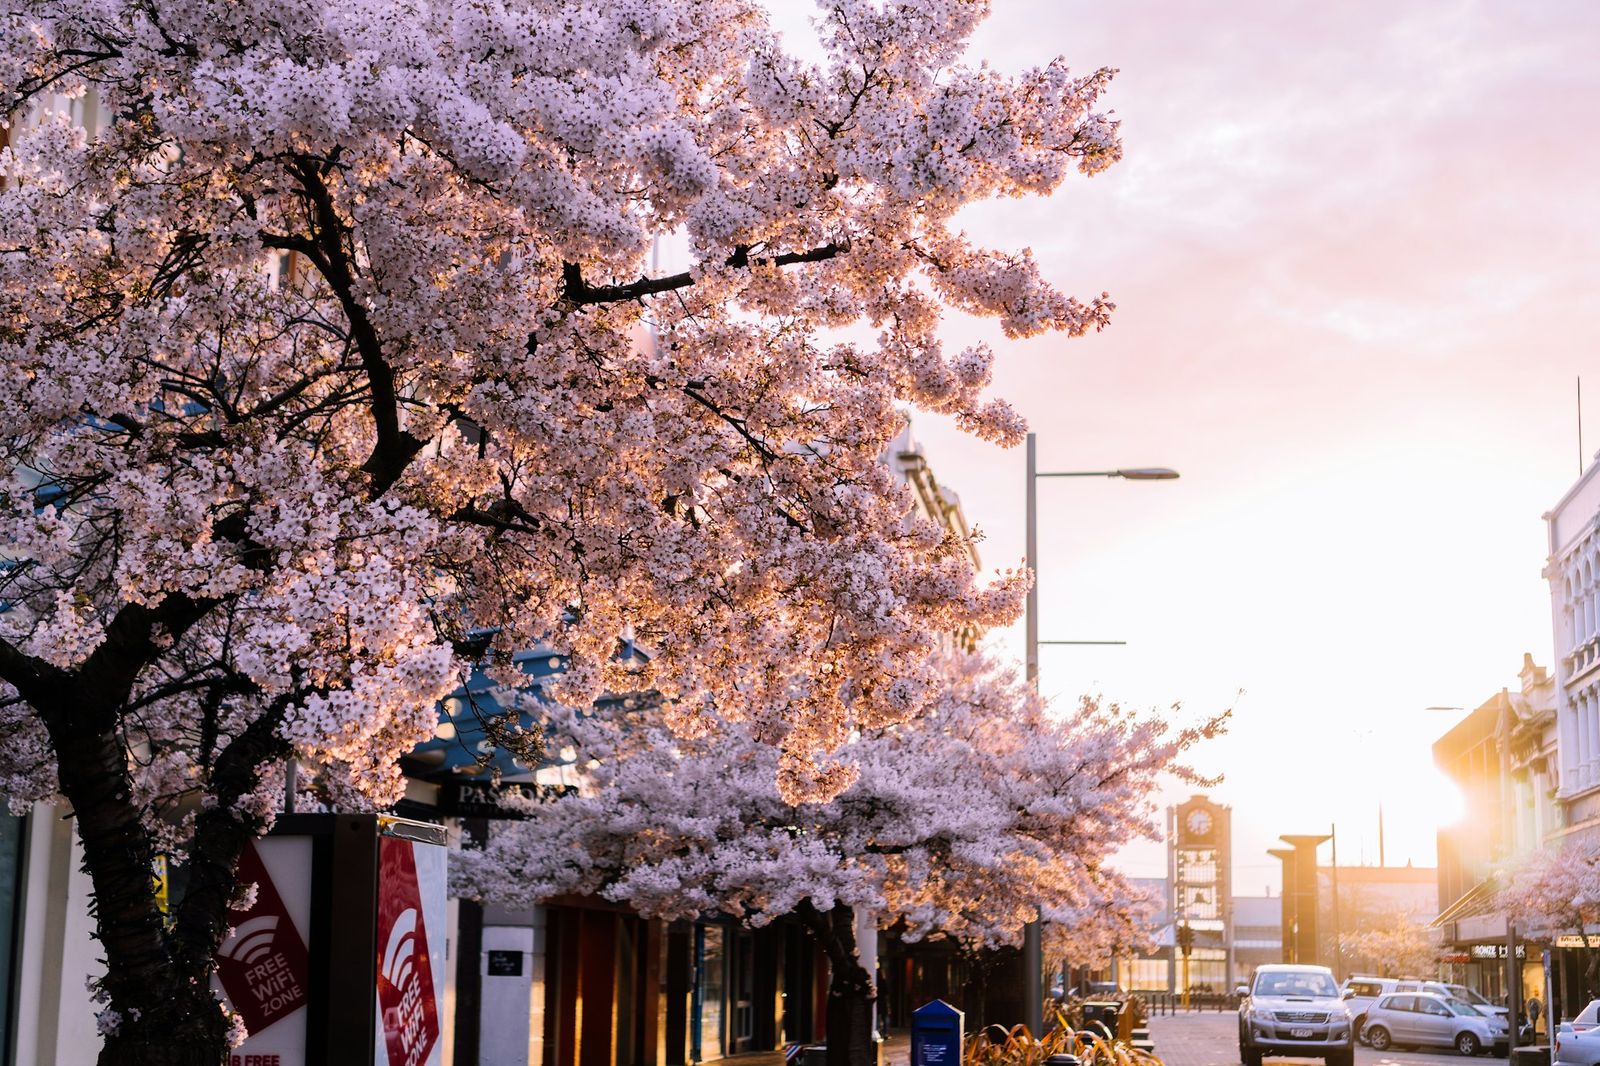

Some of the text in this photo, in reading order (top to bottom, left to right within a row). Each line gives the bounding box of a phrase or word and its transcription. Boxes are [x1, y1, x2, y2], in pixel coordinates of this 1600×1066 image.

[244, 952, 288, 986] FREE
[251, 967, 296, 1002] WiFi
[260, 984, 304, 1017] ZONE
[397, 970, 421, 1028] FREE
[400, 997, 425, 1055] WiFi
[246, 1055, 280, 1066] FREE
